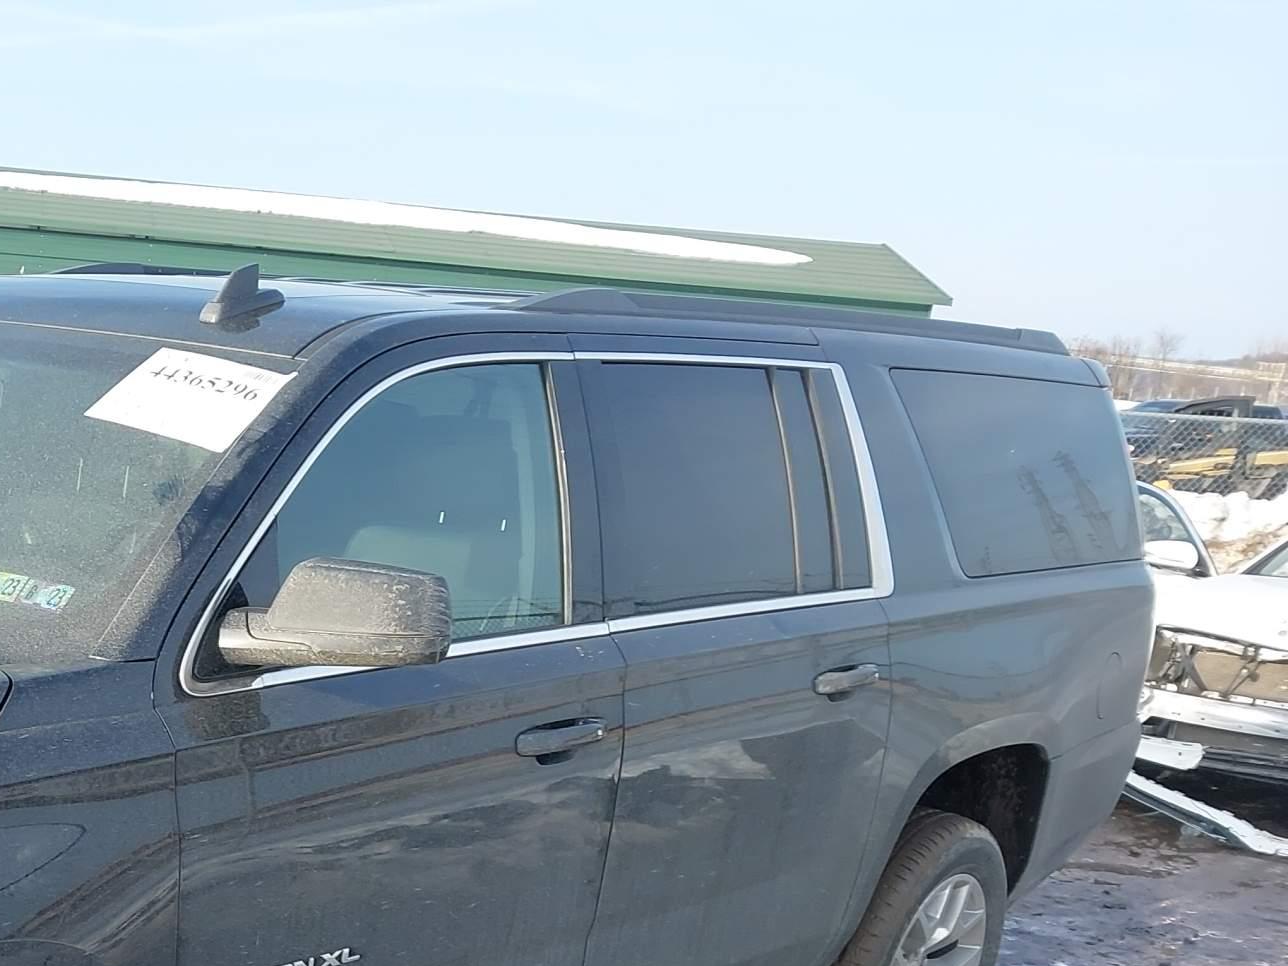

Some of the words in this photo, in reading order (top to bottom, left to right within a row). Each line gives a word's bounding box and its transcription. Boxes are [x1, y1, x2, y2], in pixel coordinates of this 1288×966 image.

[150, 366, 258, 401] 44365296
[1, 578, 22, 596] 23
[47, 588, 68, 607] 23
